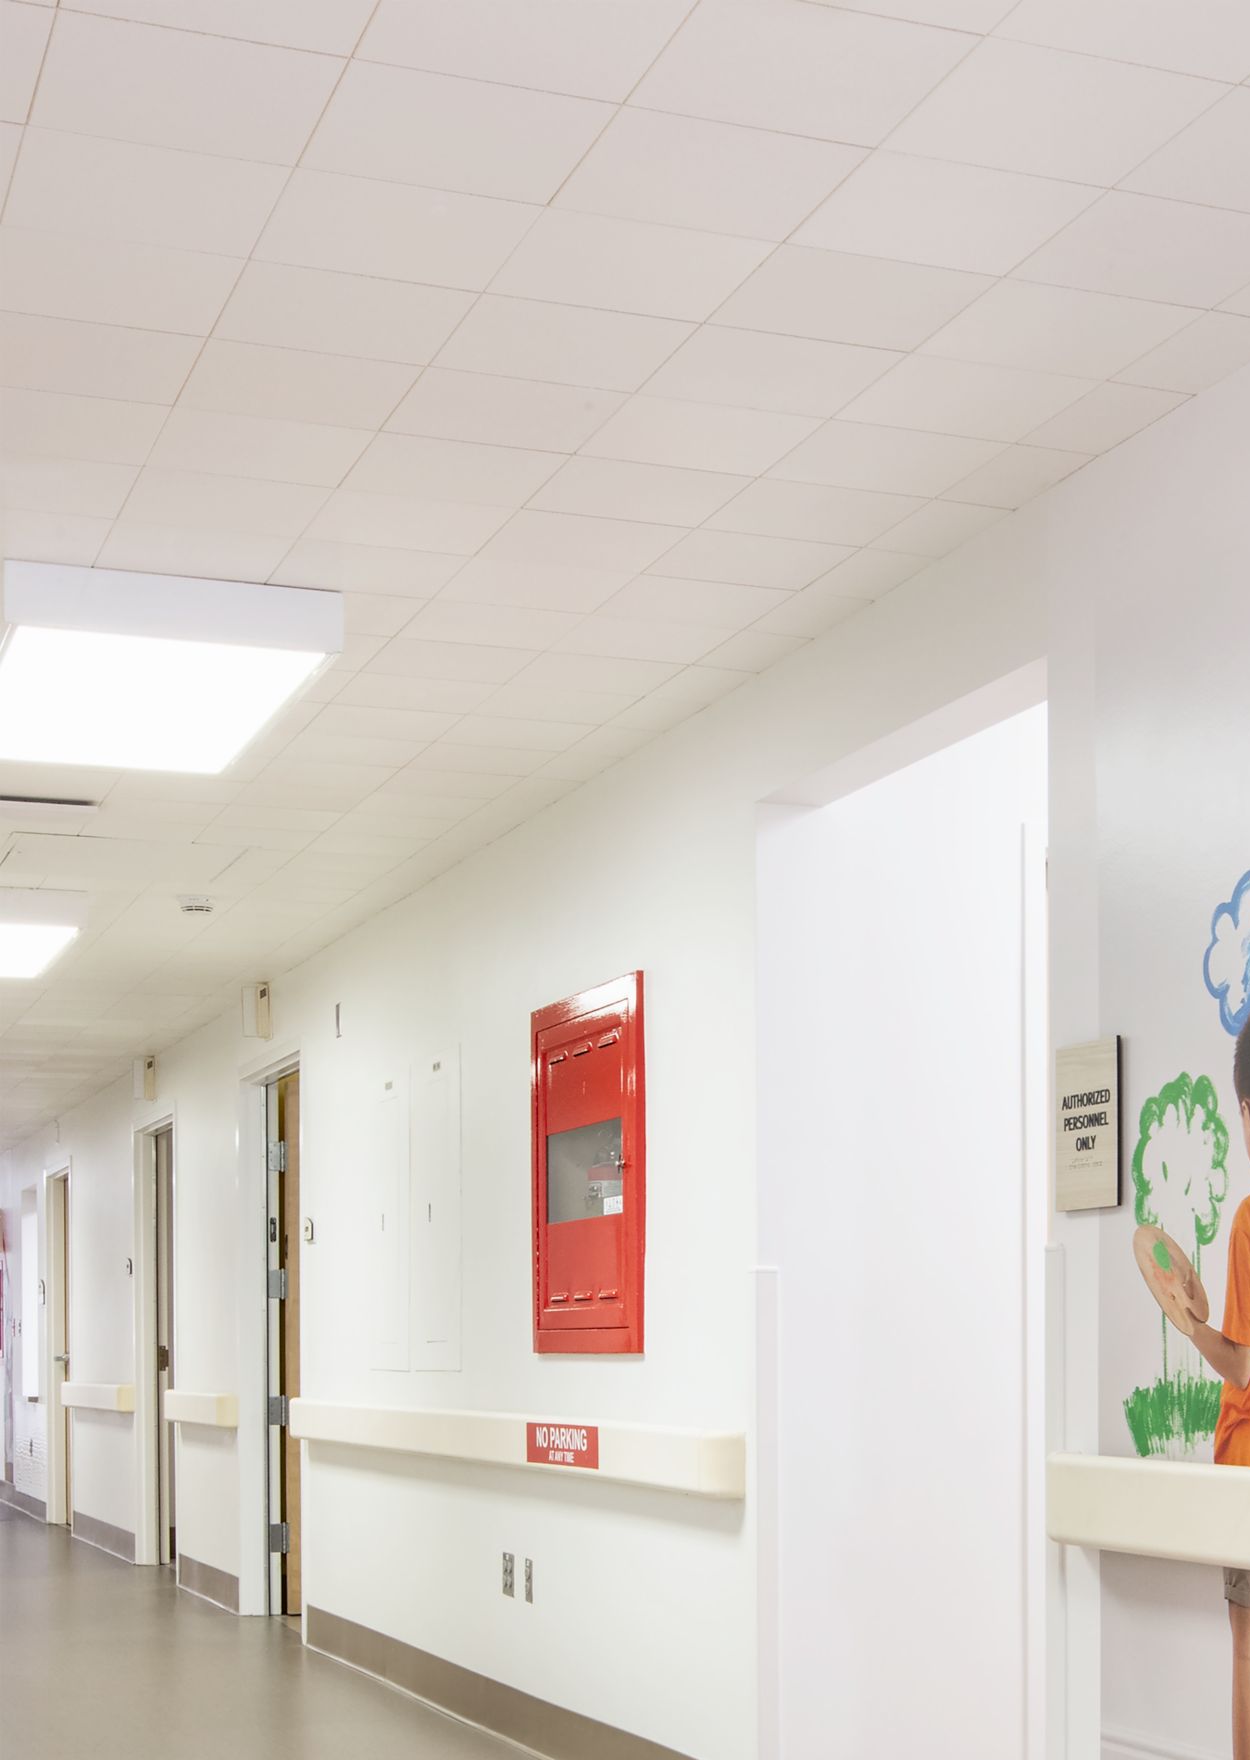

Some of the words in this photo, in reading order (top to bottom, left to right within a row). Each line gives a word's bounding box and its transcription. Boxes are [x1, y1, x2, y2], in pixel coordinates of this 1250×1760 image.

[1062, 1089, 1110, 1110] AUTHORIZED
[1064, 1112, 1109, 1131] PERSONNEL
[1076, 1135, 1096, 1151] ONLY
[536, 1427, 548, 1447] NO
[550, 1427, 587, 1451] PARKING
[549, 1451, 554, 1461] AT
